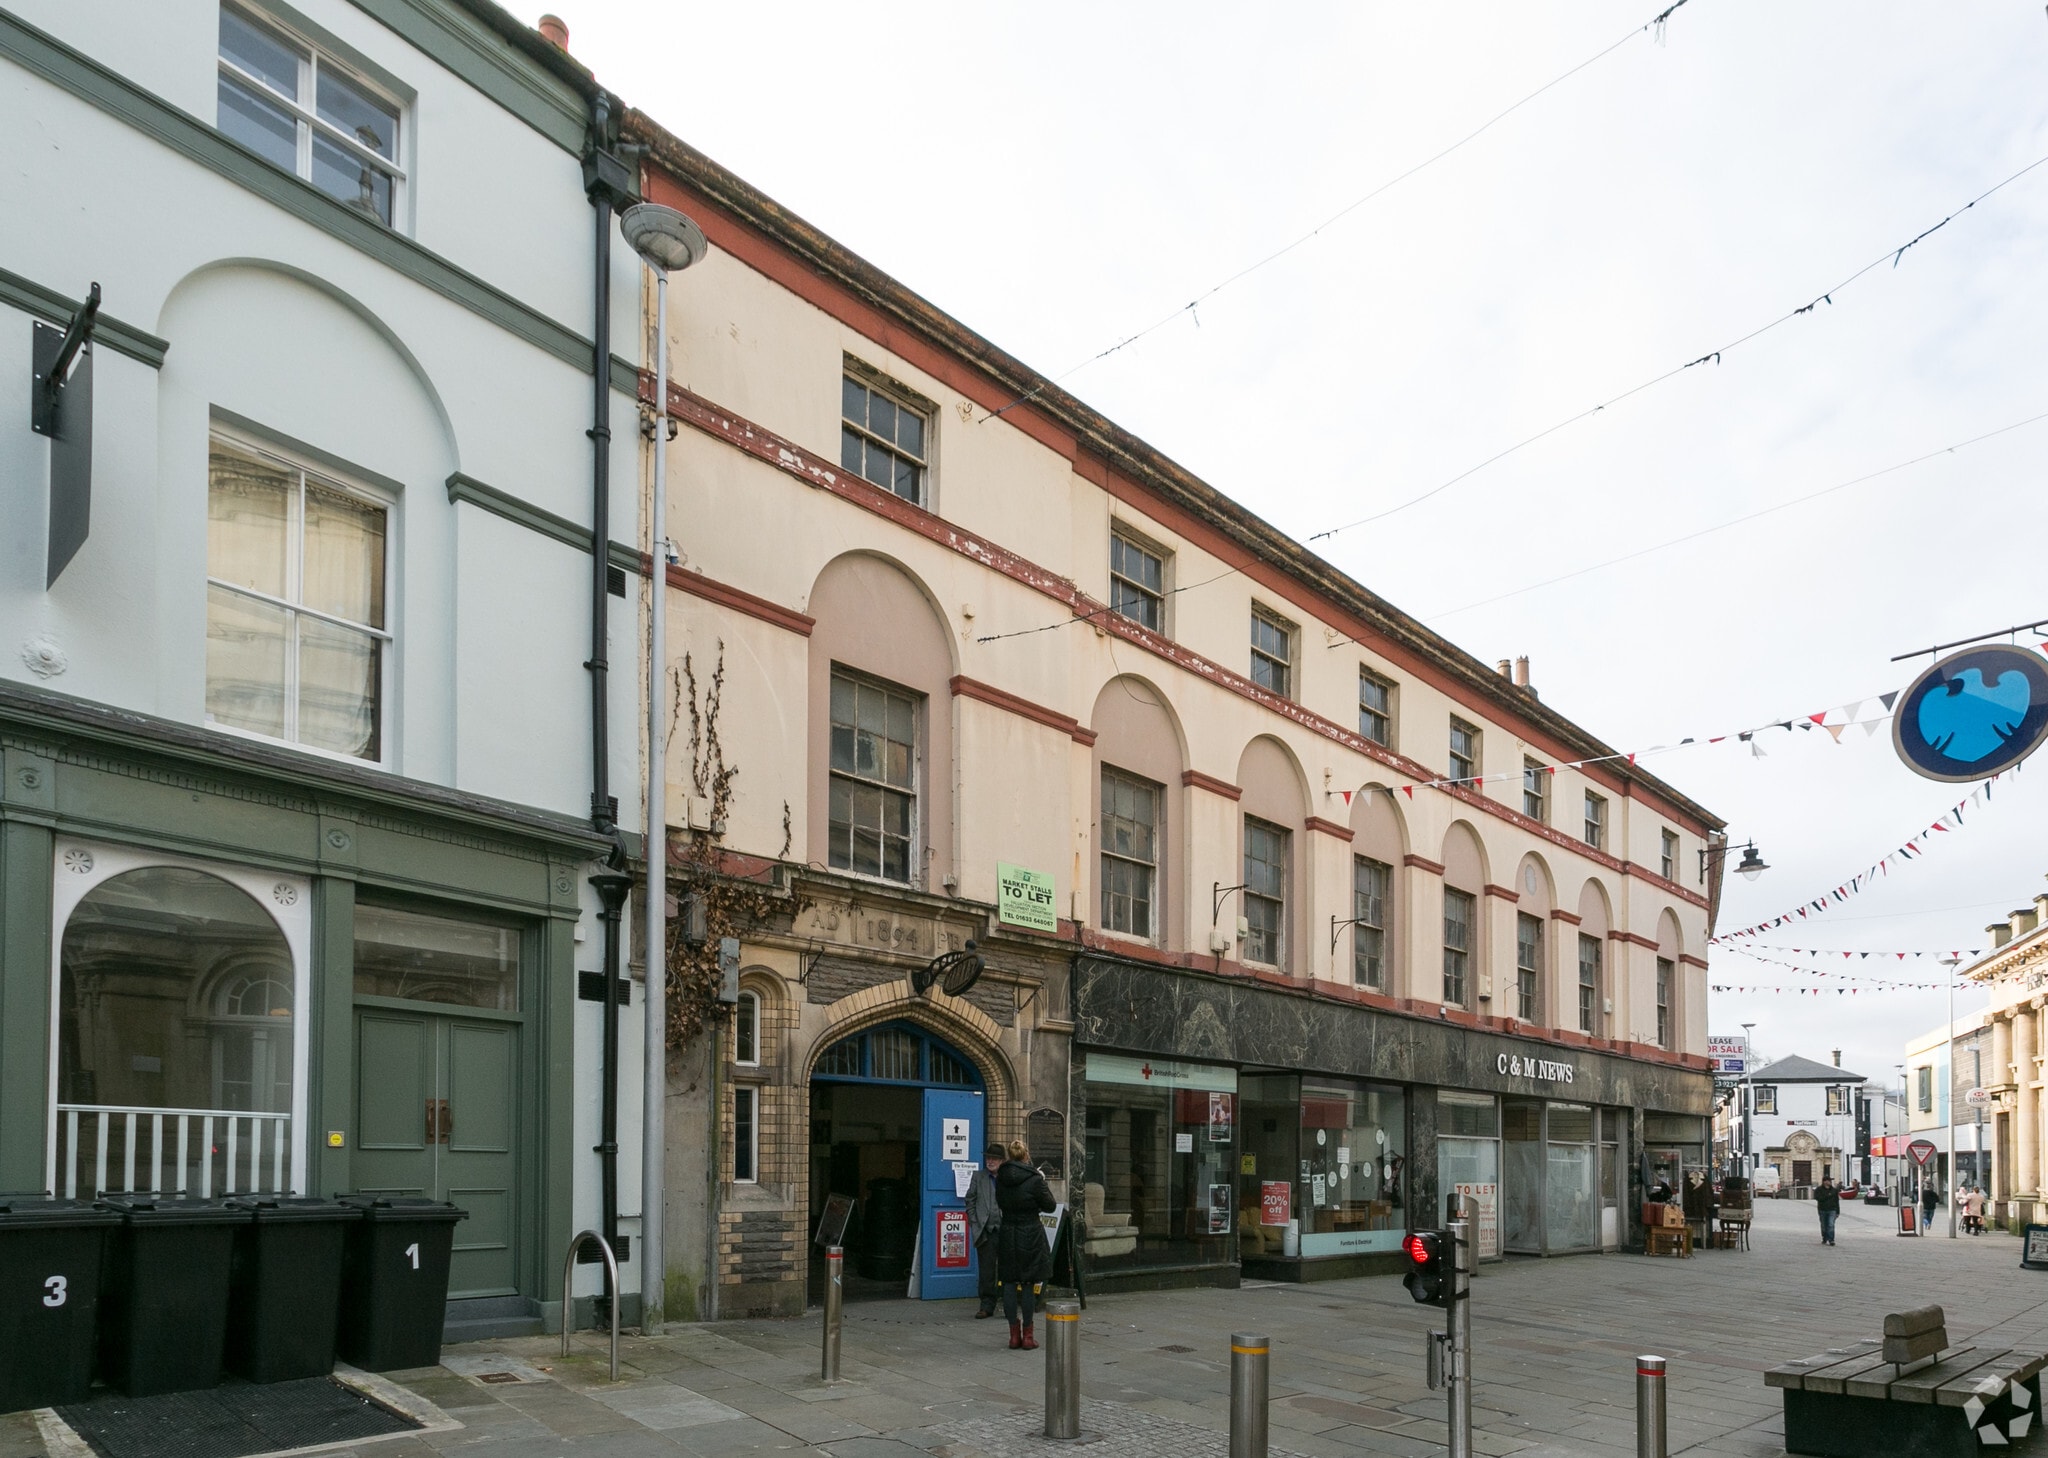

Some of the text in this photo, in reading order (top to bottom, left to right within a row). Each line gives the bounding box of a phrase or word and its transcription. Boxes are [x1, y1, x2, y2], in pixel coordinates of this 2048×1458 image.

[1002, 879, 1052, 895] MARKET STALLS
[1003, 885, 1052, 905] TO LET
[810, 908, 840, 932] AD
[866, 919, 918, 951] 1894
[1708, 1045, 1744, 1053] OR SALE
[1497, 1053, 1573, 1083] C & M NEWS
[1456, 1185, 1496, 1195] TO LET
[1263, 1195, 1288, 1206] 20%
[944, 1212, 964, 1220] Sun
[1269, 1206, 1283, 1214] off
[946, 1223, 960, 1231] ON
[405, 1243, 420, 1269] 1
[43, 1275, 67, 1307] 3
